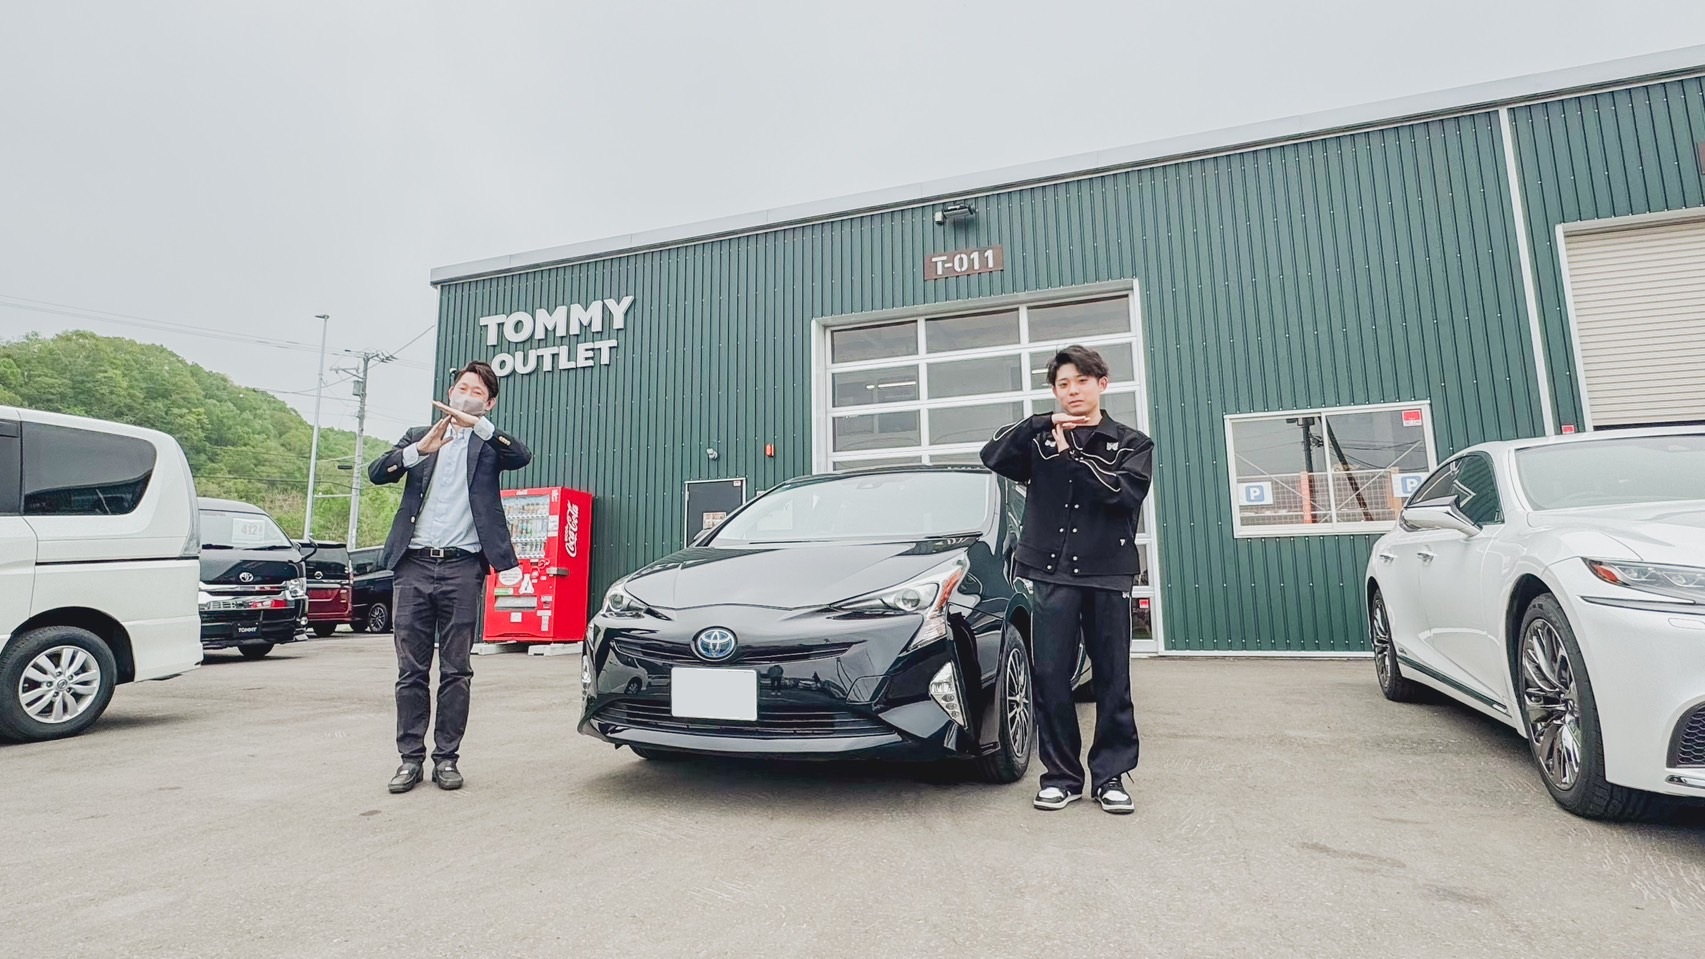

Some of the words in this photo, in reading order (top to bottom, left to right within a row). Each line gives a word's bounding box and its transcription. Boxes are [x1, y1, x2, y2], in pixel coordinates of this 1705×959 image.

[932, 249, 994, 275] T-011
[479, 295, 635, 346] TOMMY
[491, 339, 618, 378] OUTLET
